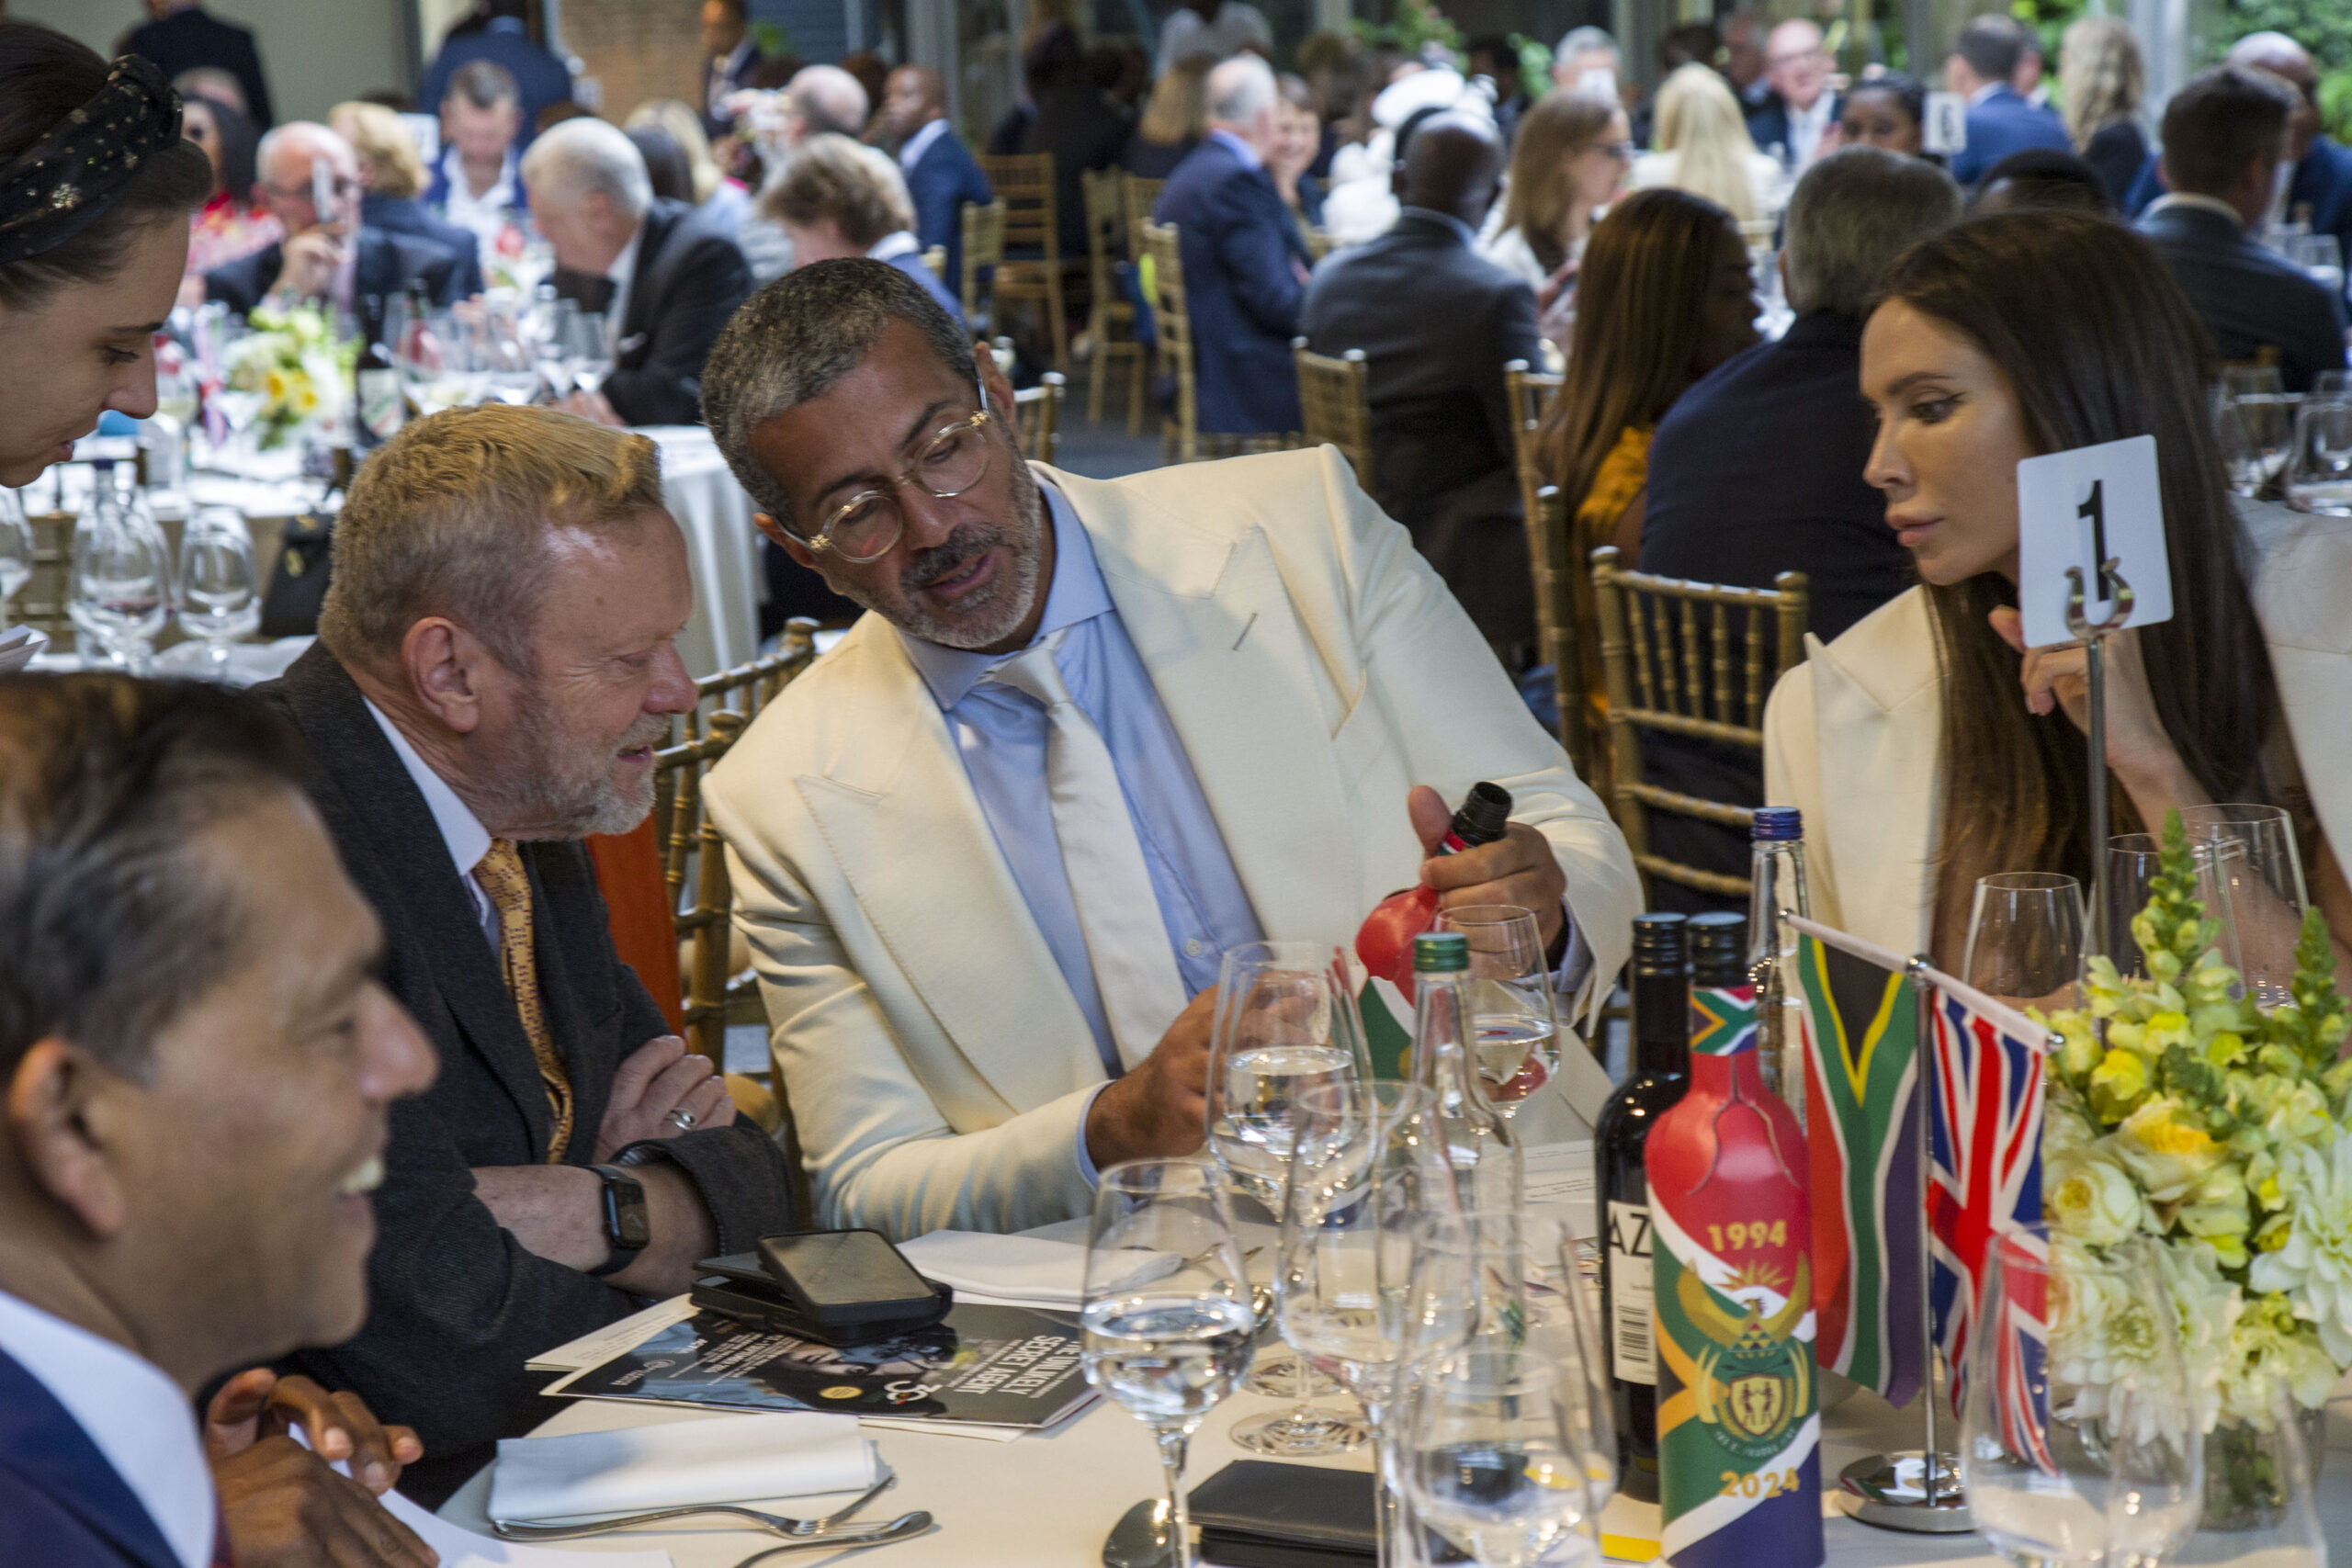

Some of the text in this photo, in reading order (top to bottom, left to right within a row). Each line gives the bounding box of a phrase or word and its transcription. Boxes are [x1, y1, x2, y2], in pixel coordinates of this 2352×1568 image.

[2077, 479, 2111, 602] 1
[1707, 1220, 1788, 1251] 1994
[997, 1335, 1067, 1367] SECRET
[953, 1367, 1019, 1394] AGENT
[1719, 1467, 1800, 1499] 2024
